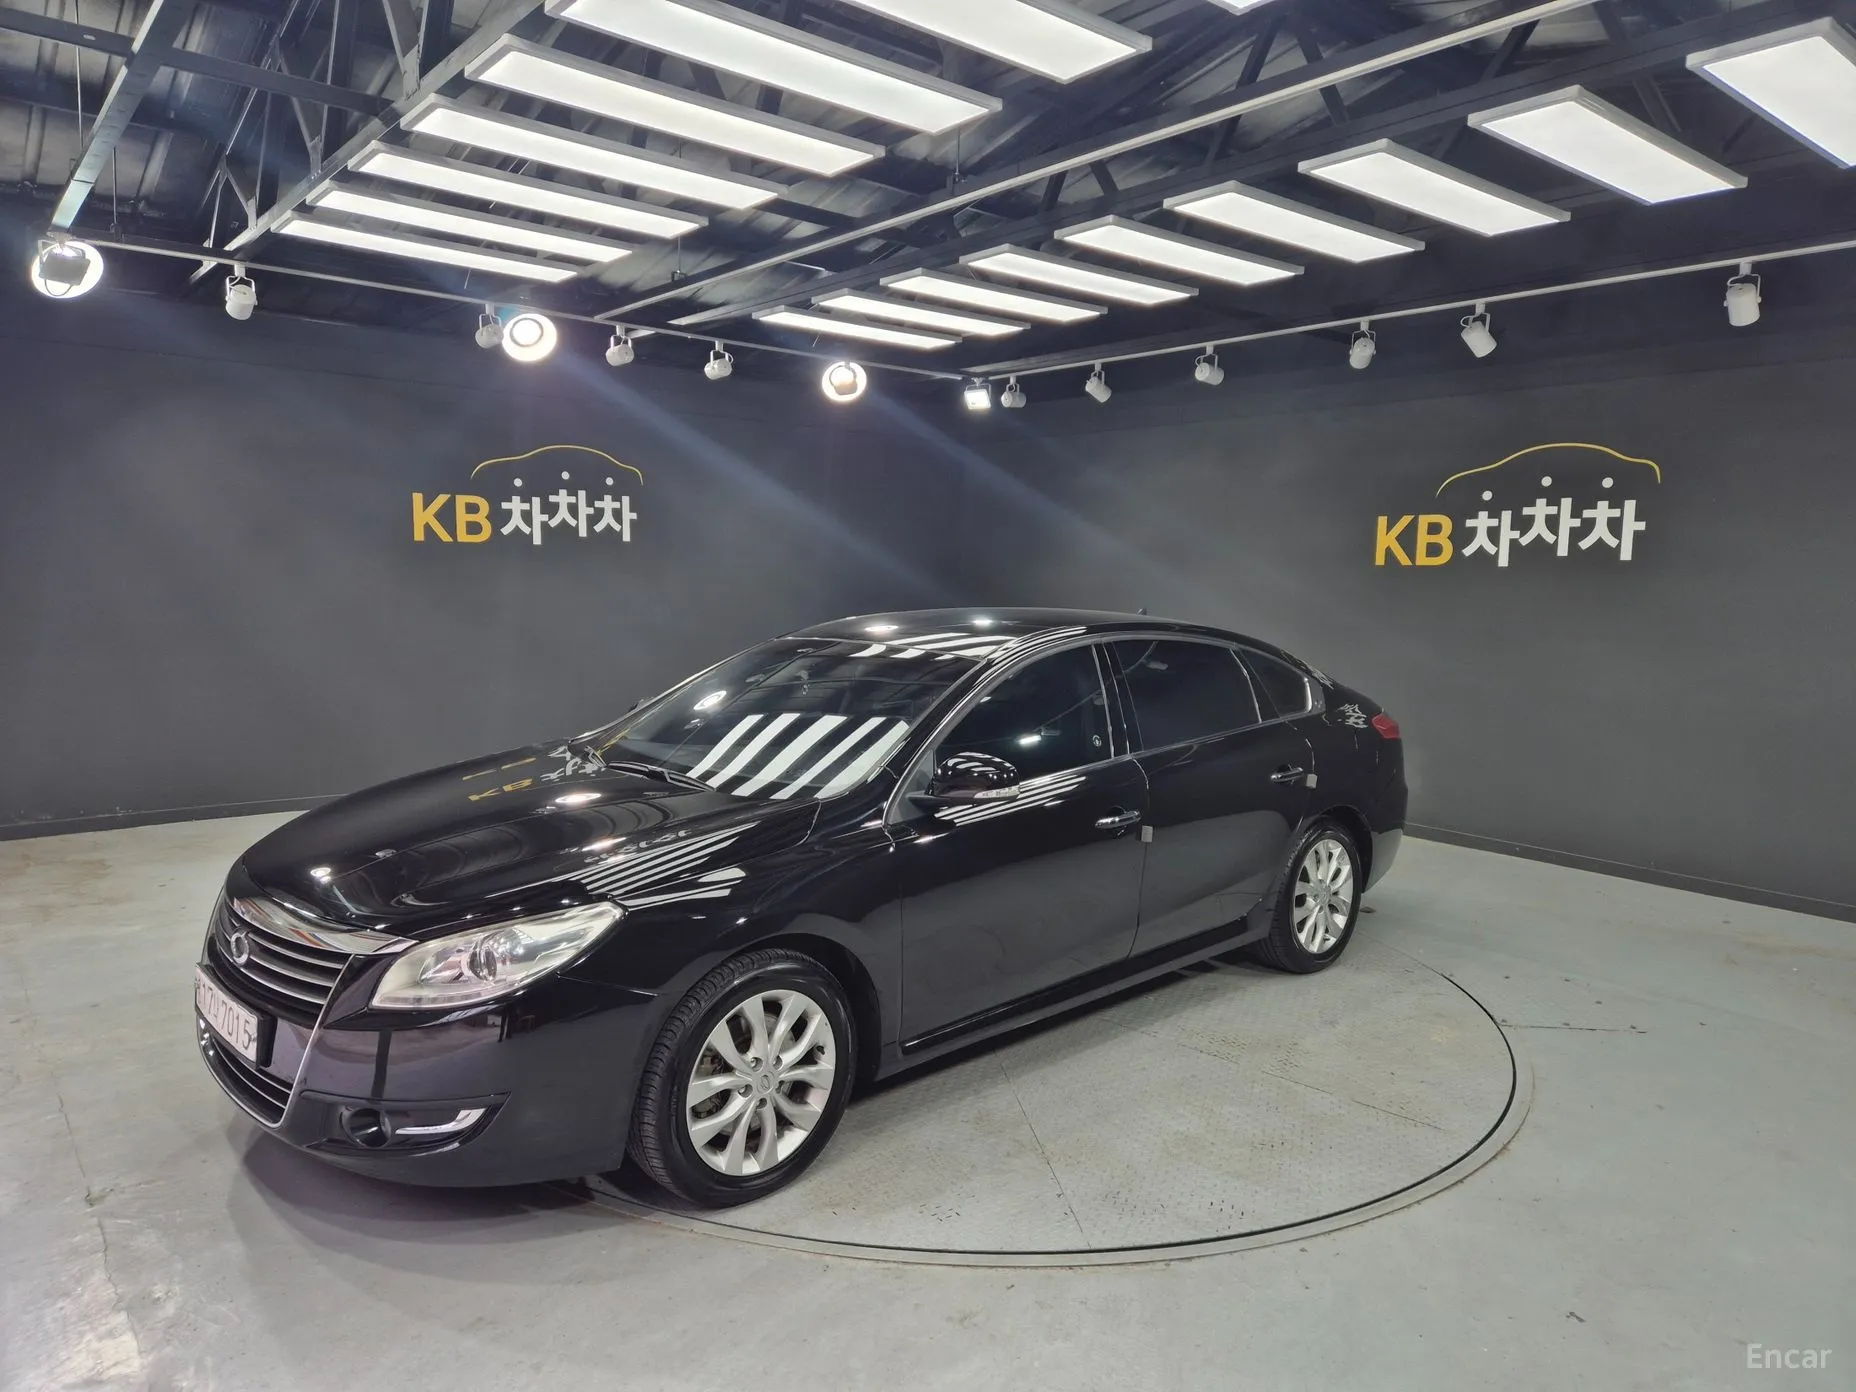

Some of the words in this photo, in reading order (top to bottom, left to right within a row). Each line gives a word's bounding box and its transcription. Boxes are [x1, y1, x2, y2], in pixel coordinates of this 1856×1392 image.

[412, 492, 492, 543] KB
[500, 471, 638, 545] 차차차
[1375, 514, 1454, 566] KB
[1462, 475, 1646, 567] 차차차
[222, 1000, 252, 1050] 7015
